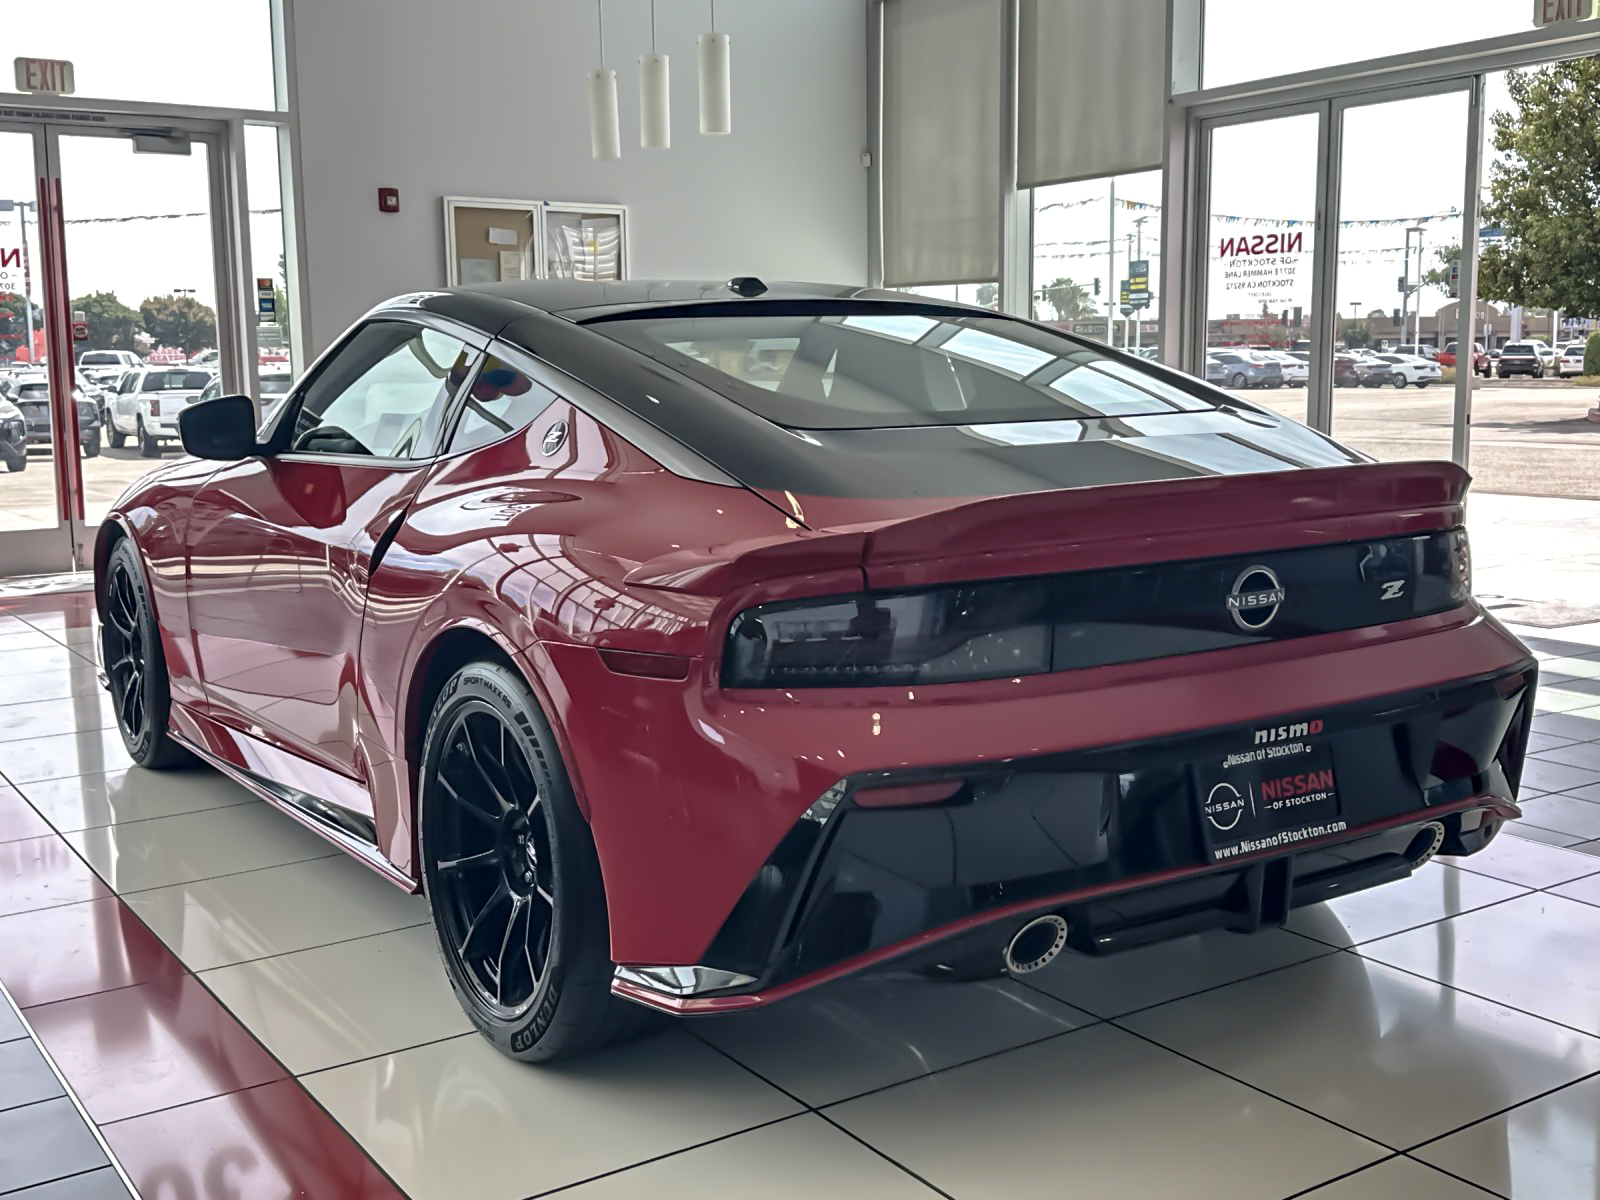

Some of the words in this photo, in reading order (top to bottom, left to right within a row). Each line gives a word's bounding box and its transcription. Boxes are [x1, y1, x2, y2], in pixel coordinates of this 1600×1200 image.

[25, 59, 67, 92] EXIT
[1228, 587, 1286, 608] NISSAN
[1380, 579, 1406, 600] Z
[463, 676, 484, 686] SPORT
[483, 680, 503, 698] MAXX
[1227, 750, 1257, 767] Nissan
[1256, 747, 1266, 761] of
[1266, 742, 1305, 759] Stockton
[1261, 768, 1335, 801] NISSAN
[1204, 799, 1245, 814] NISSAN
[1272, 800, 1284, 810] OF
[1285, 792, 1327, 807] STOCKTON
[1214, 821, 1347, 860] www.NissanofStockton.com
